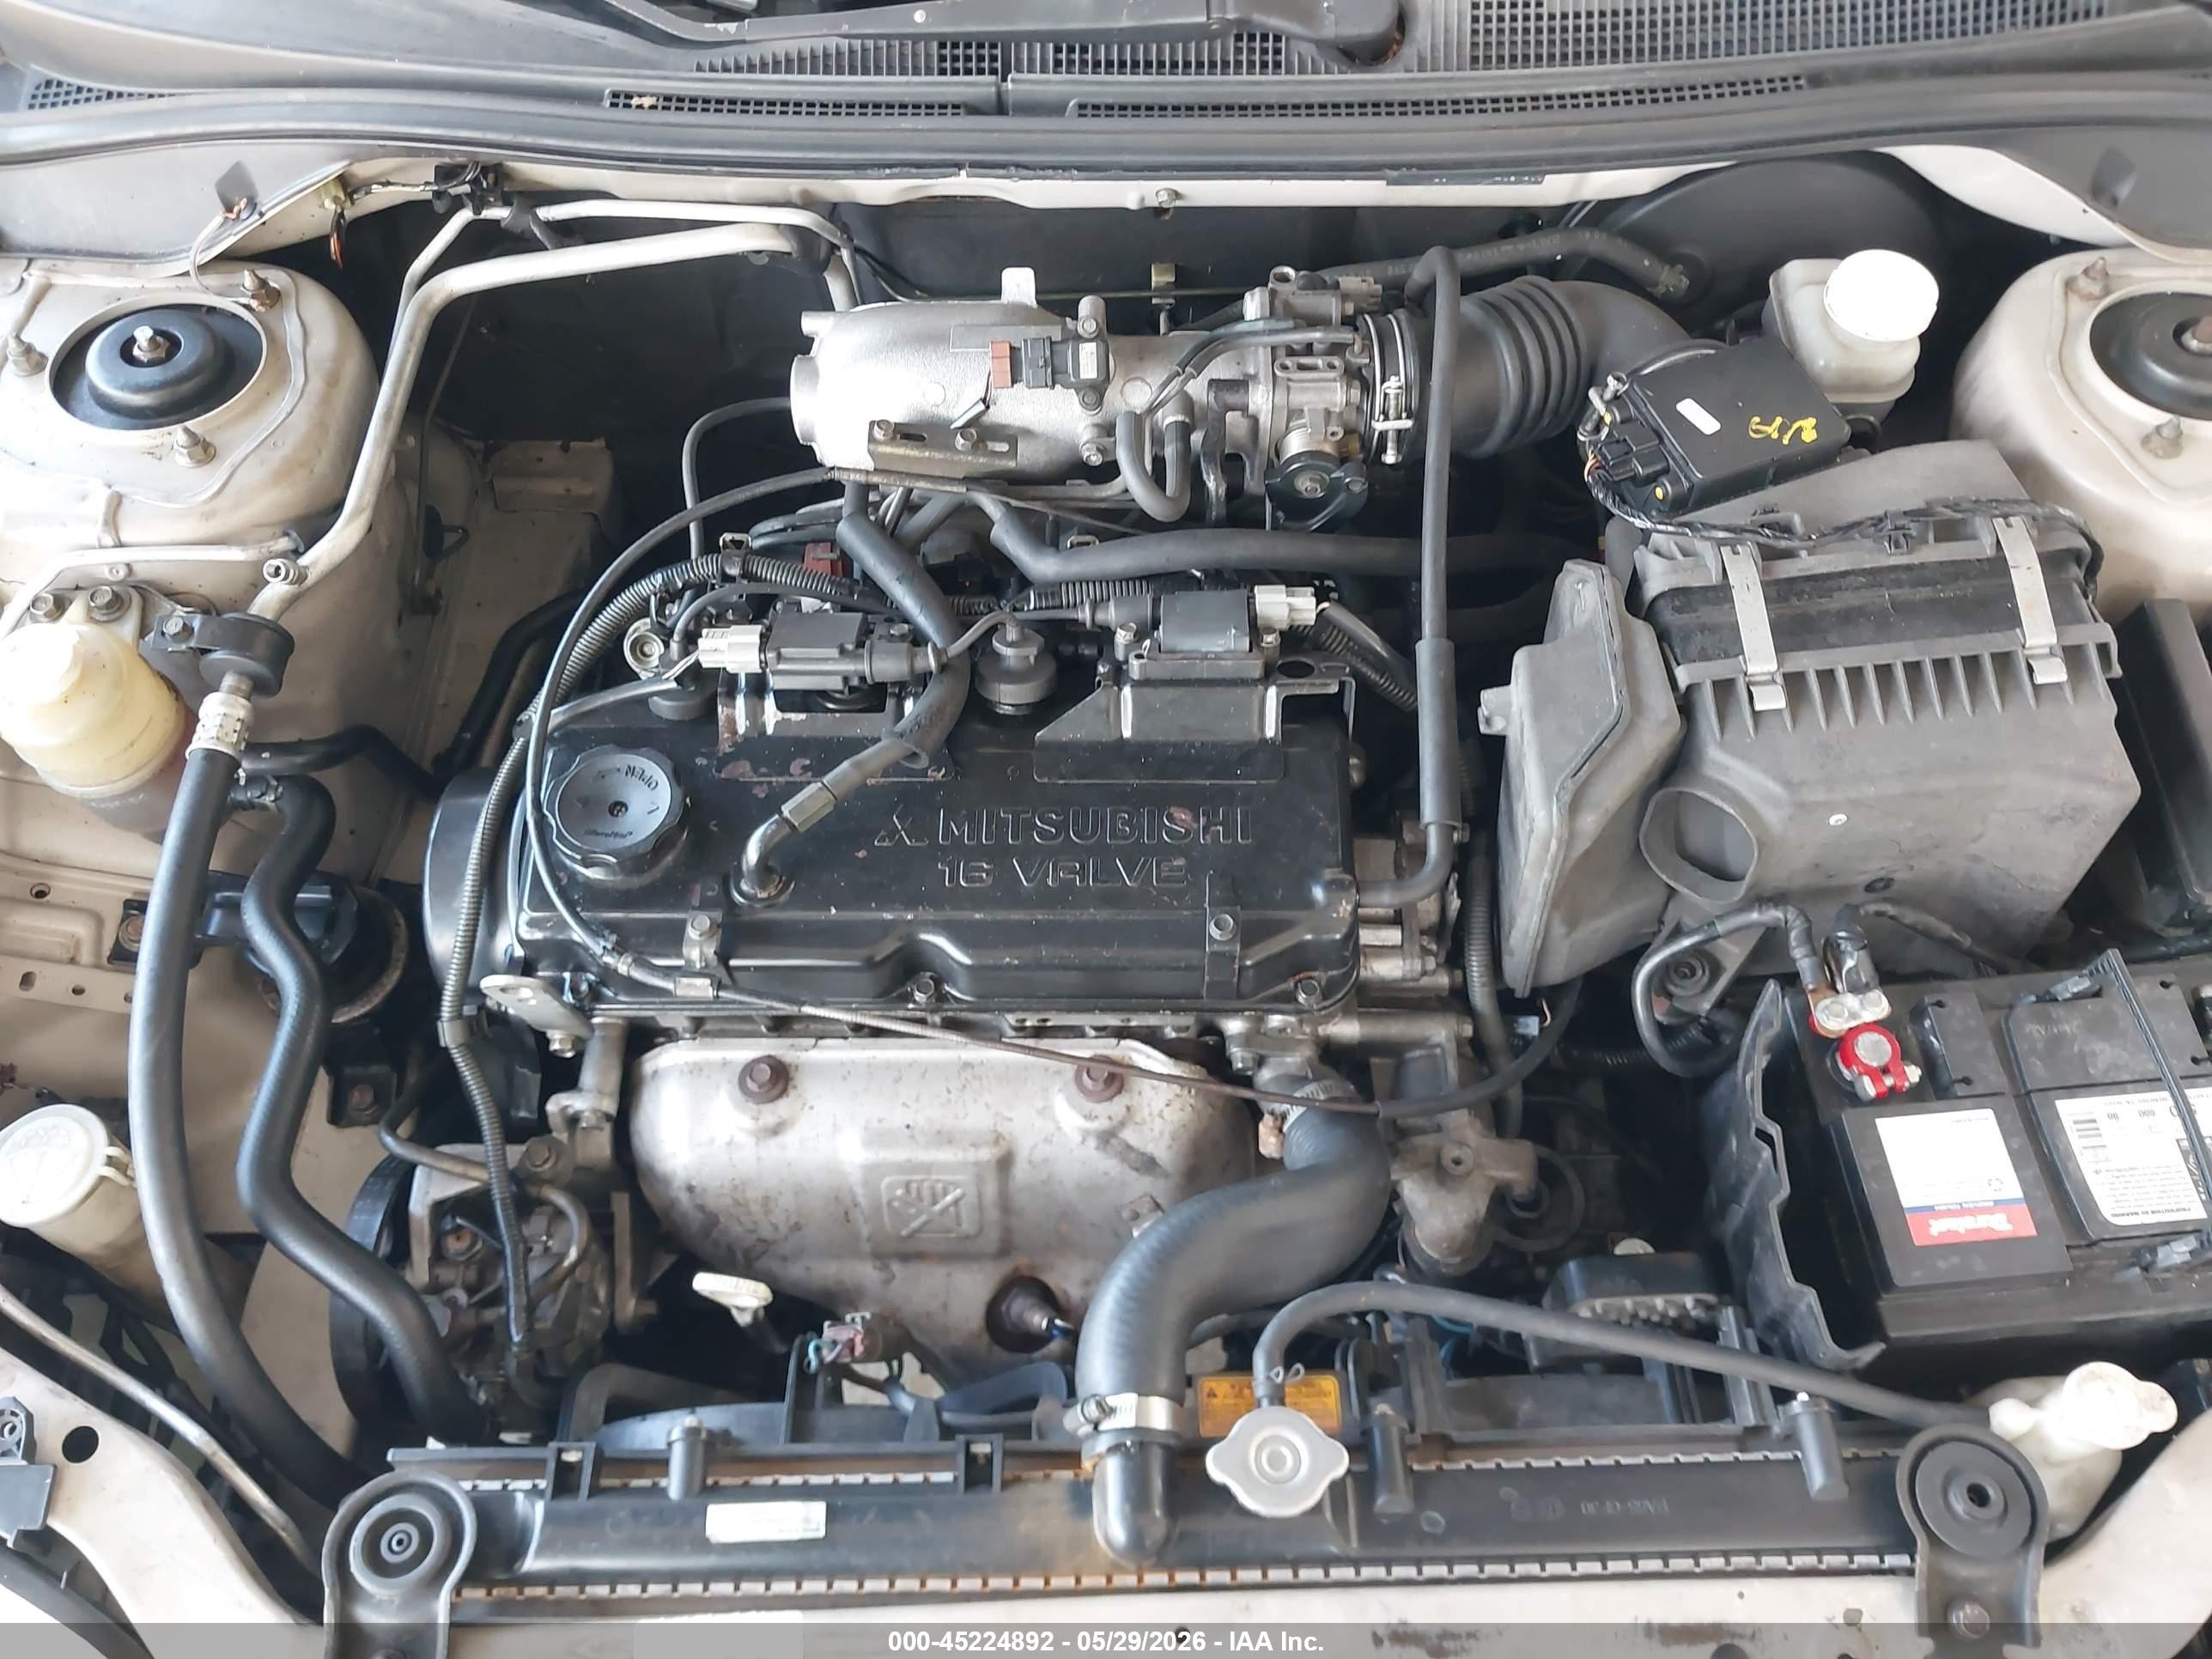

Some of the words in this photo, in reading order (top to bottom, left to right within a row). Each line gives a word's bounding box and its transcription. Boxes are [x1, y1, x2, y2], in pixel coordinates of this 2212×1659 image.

[939, 806, 1253, 845] MITSUBISHI
[938, 857, 994, 888] 16
[1012, 857, 1187, 888] VALVE
